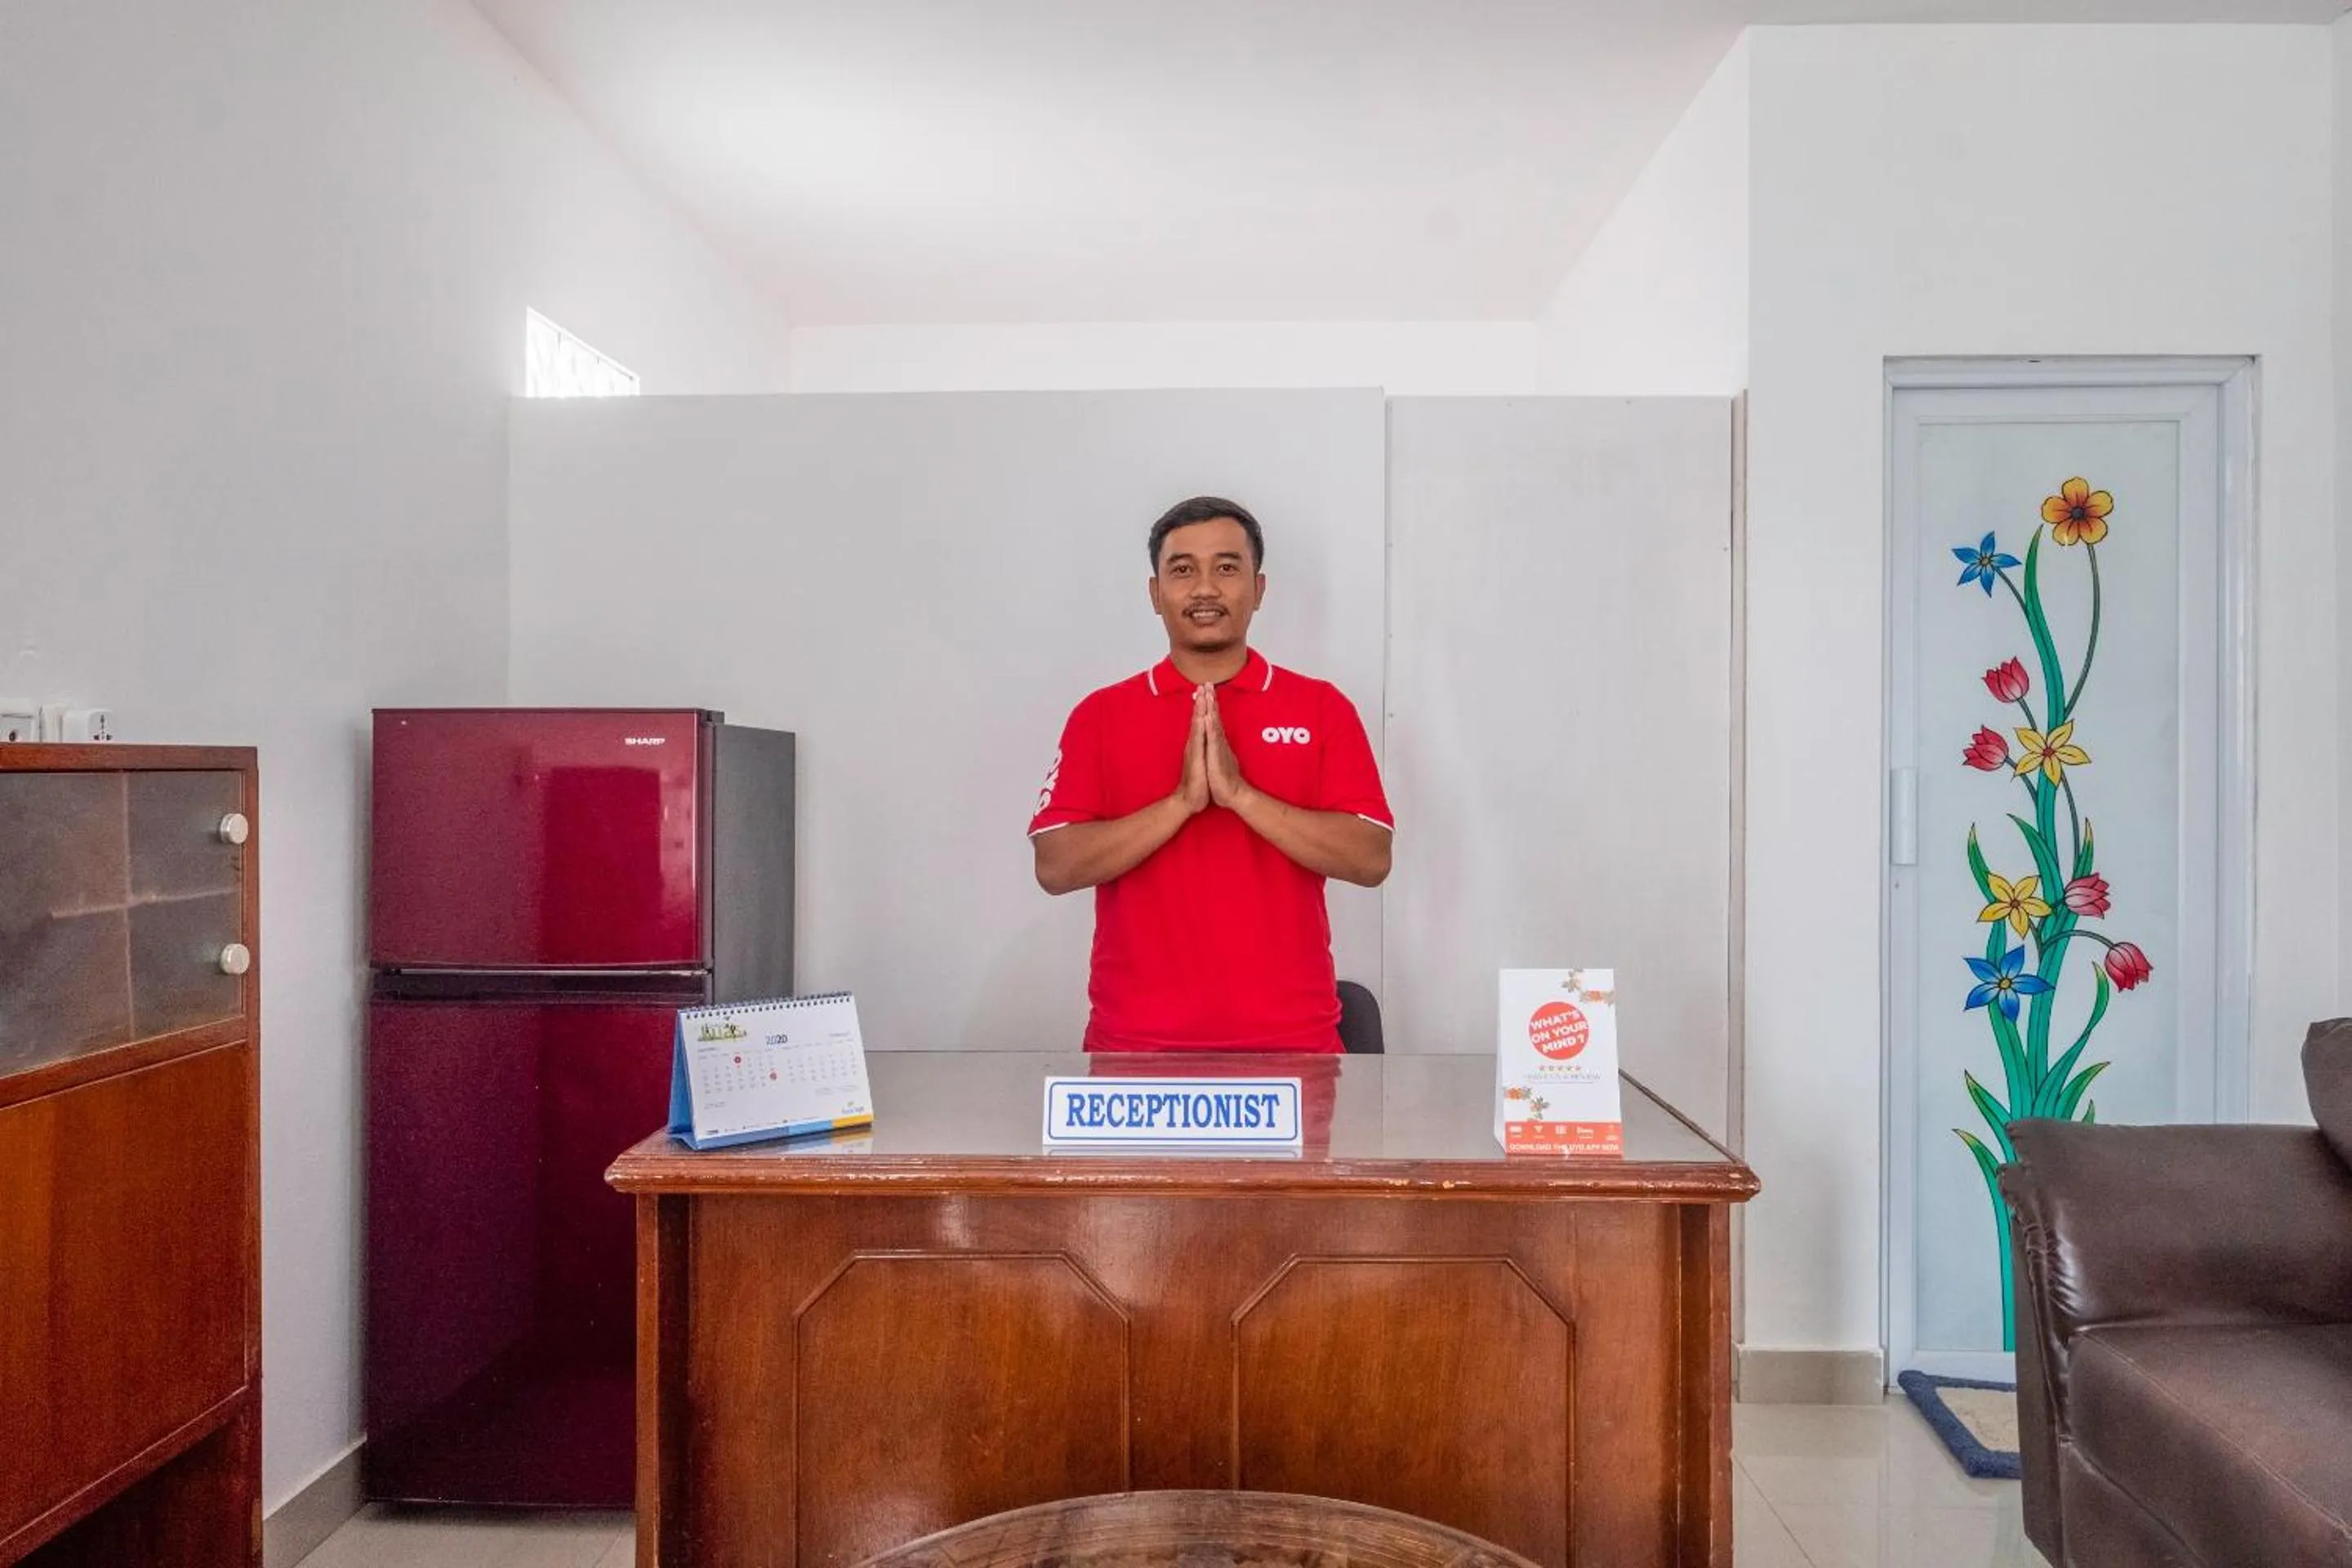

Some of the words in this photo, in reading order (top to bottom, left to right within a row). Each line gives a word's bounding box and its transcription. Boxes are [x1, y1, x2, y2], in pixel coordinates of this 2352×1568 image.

[1262, 727, 1311, 744] OYO
[1530, 1009, 1580, 1030] WHAT'S
[766, 1035, 788, 1045] 2020
[1531, 1031, 1550, 1044] ON
[1551, 1021, 1588, 1036] YOUR
[1066, 1094, 1280, 1128] RECEPTIONIST
[1508, 1143, 1552, 1152] DOWNLOAD
